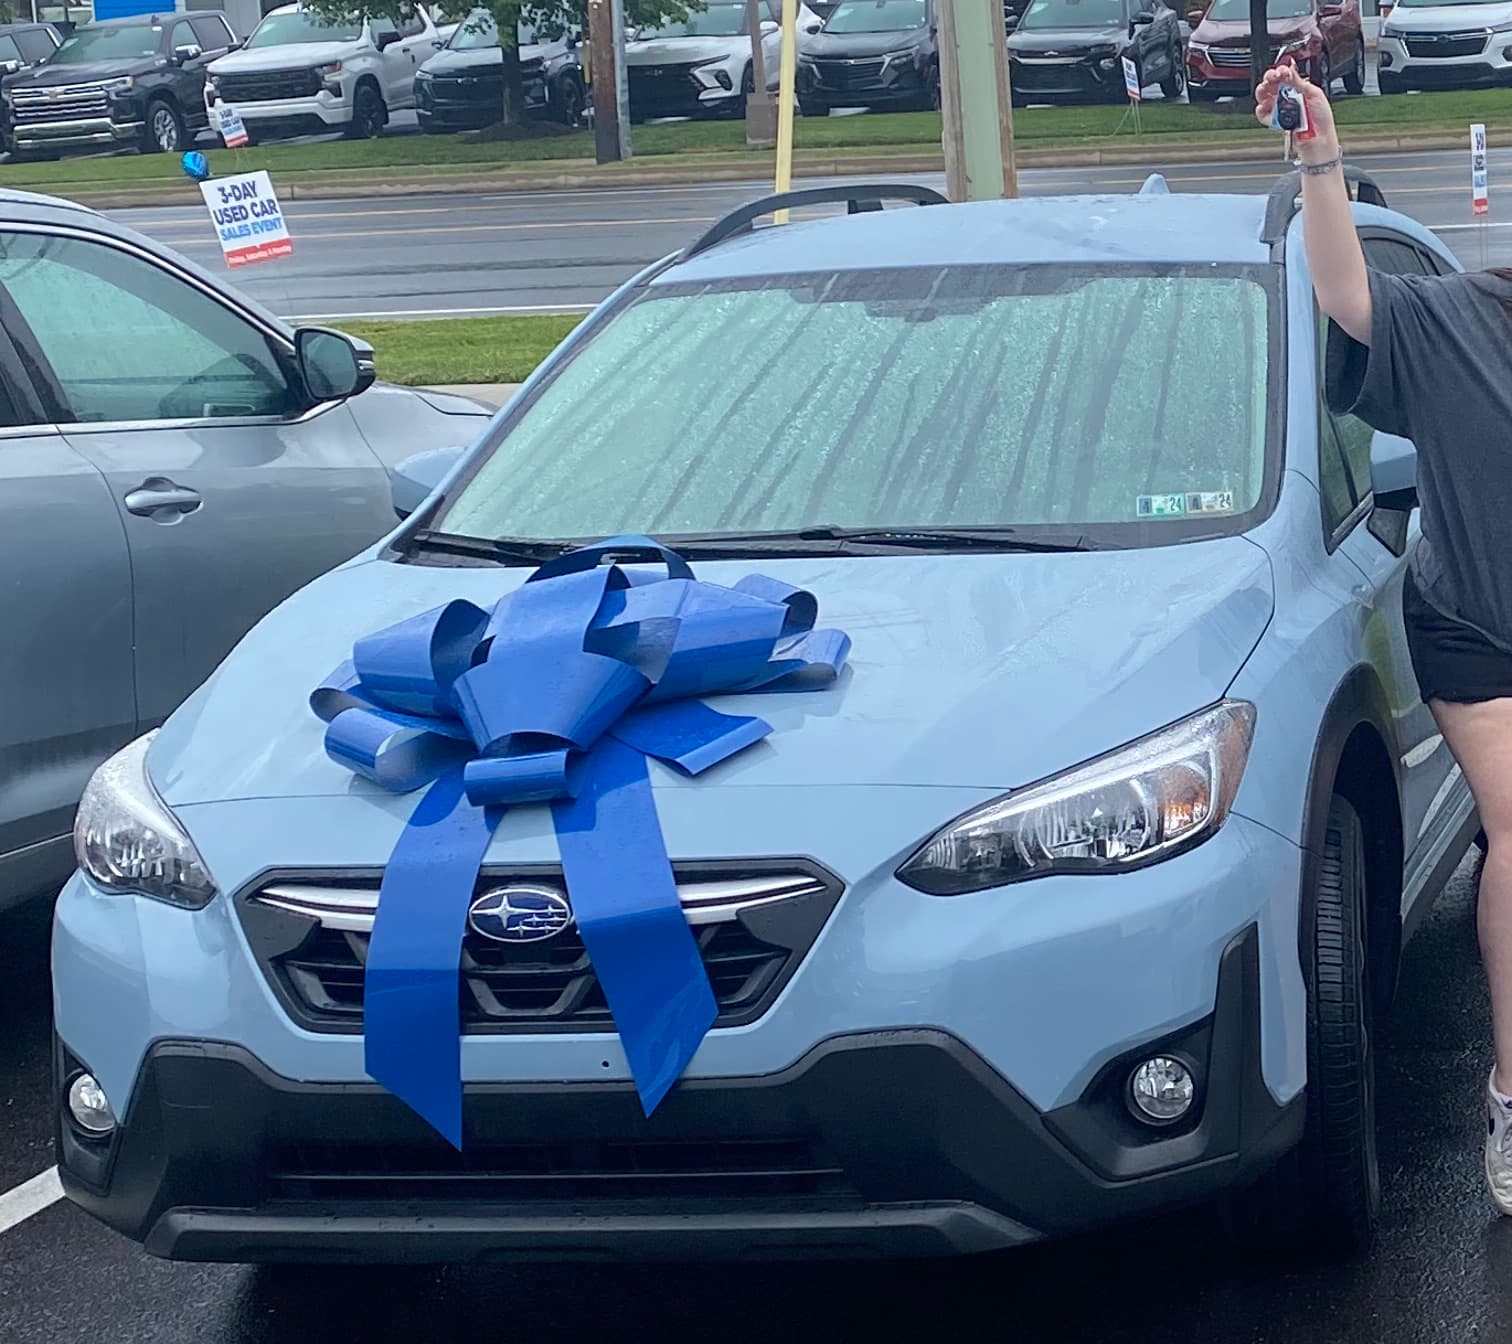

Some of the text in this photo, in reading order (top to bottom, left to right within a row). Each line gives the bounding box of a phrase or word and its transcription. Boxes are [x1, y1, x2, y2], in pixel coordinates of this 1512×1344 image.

[217, 180, 258, 204] 3-DAY
[213, 198, 279, 226] USED CAR
[219, 216, 283, 241] SALES EVENT
